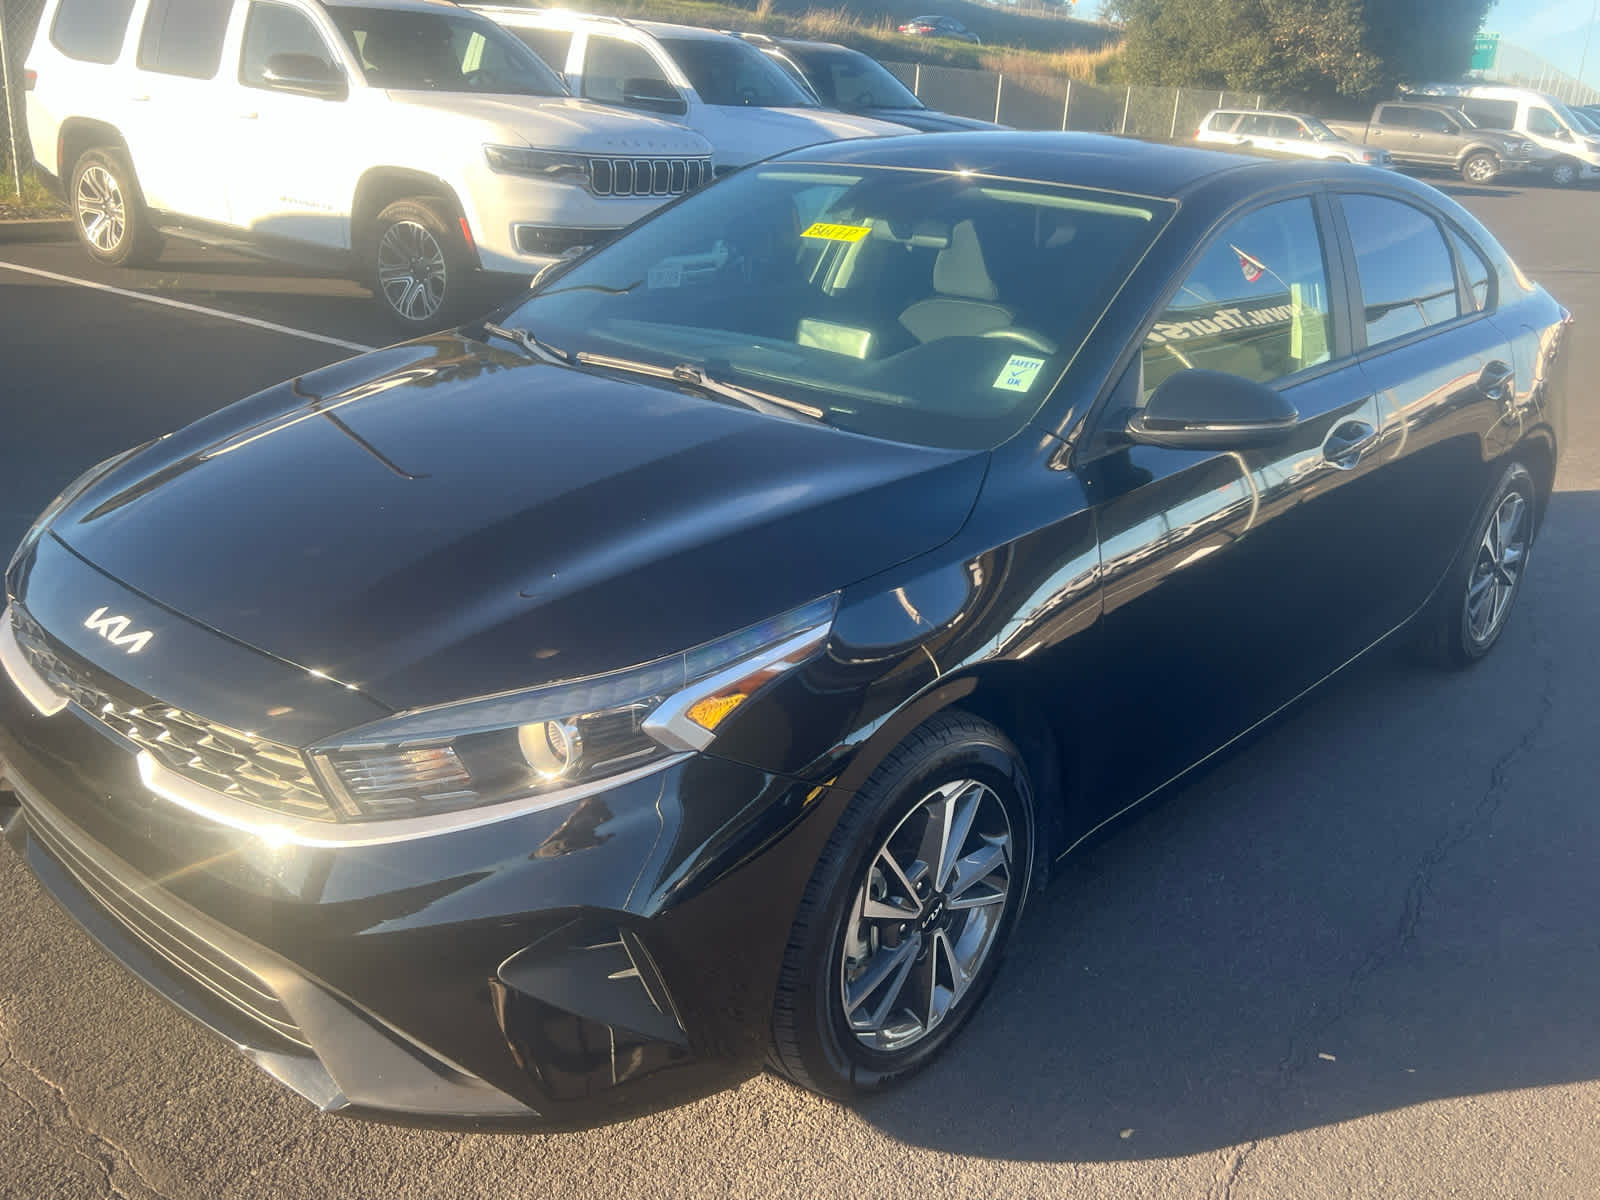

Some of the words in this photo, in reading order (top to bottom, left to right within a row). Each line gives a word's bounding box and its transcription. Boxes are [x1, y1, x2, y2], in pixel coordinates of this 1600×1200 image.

[1010, 359, 1041, 369] SAFETY
[1007, 378, 1020, 386] OK
[84, 606, 154, 654] KIA
